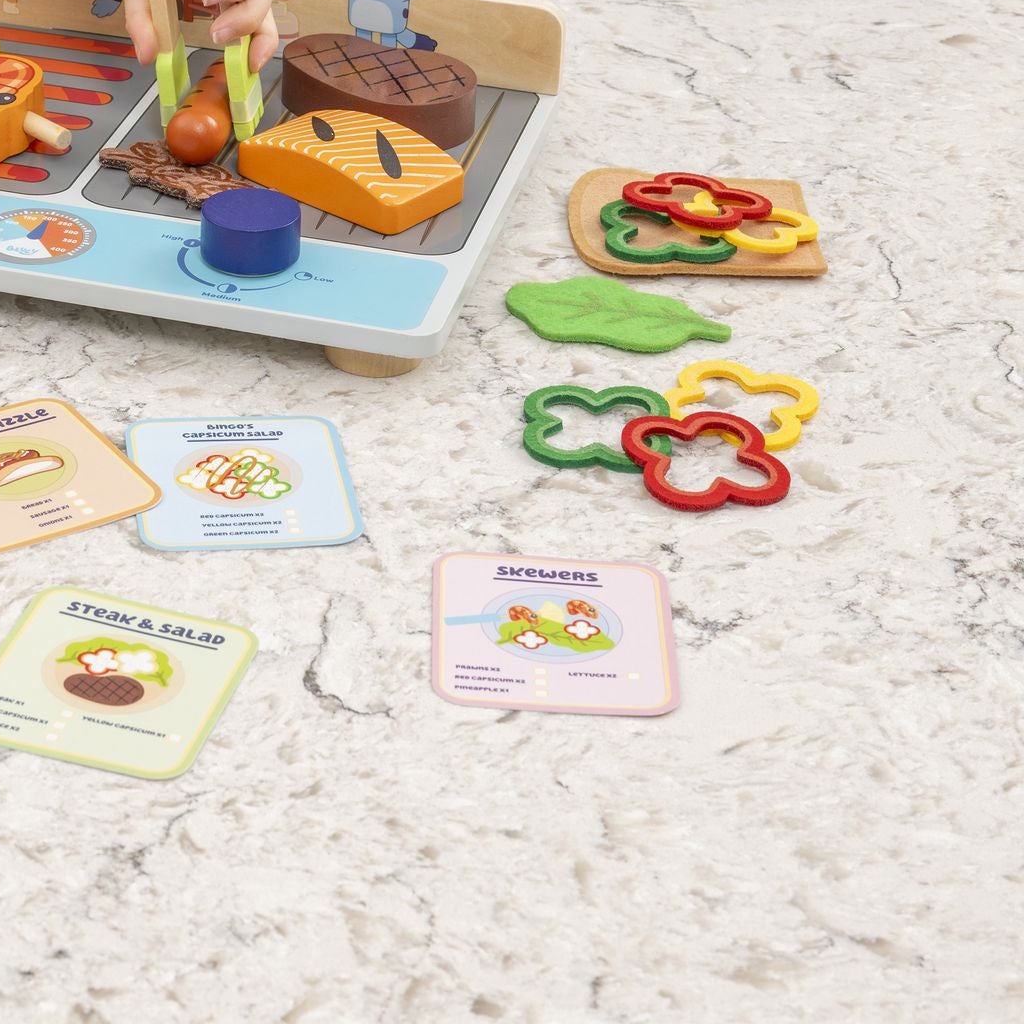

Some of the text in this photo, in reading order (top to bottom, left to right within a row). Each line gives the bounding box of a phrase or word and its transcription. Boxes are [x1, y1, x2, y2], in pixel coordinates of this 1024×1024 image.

[202, 291, 241, 301] Medium
[182, 431, 245, 439] CAPSICUM
[497, 565, 598, 582] SKEWERS
[67, 601, 225, 645] STEAK & SALAD
